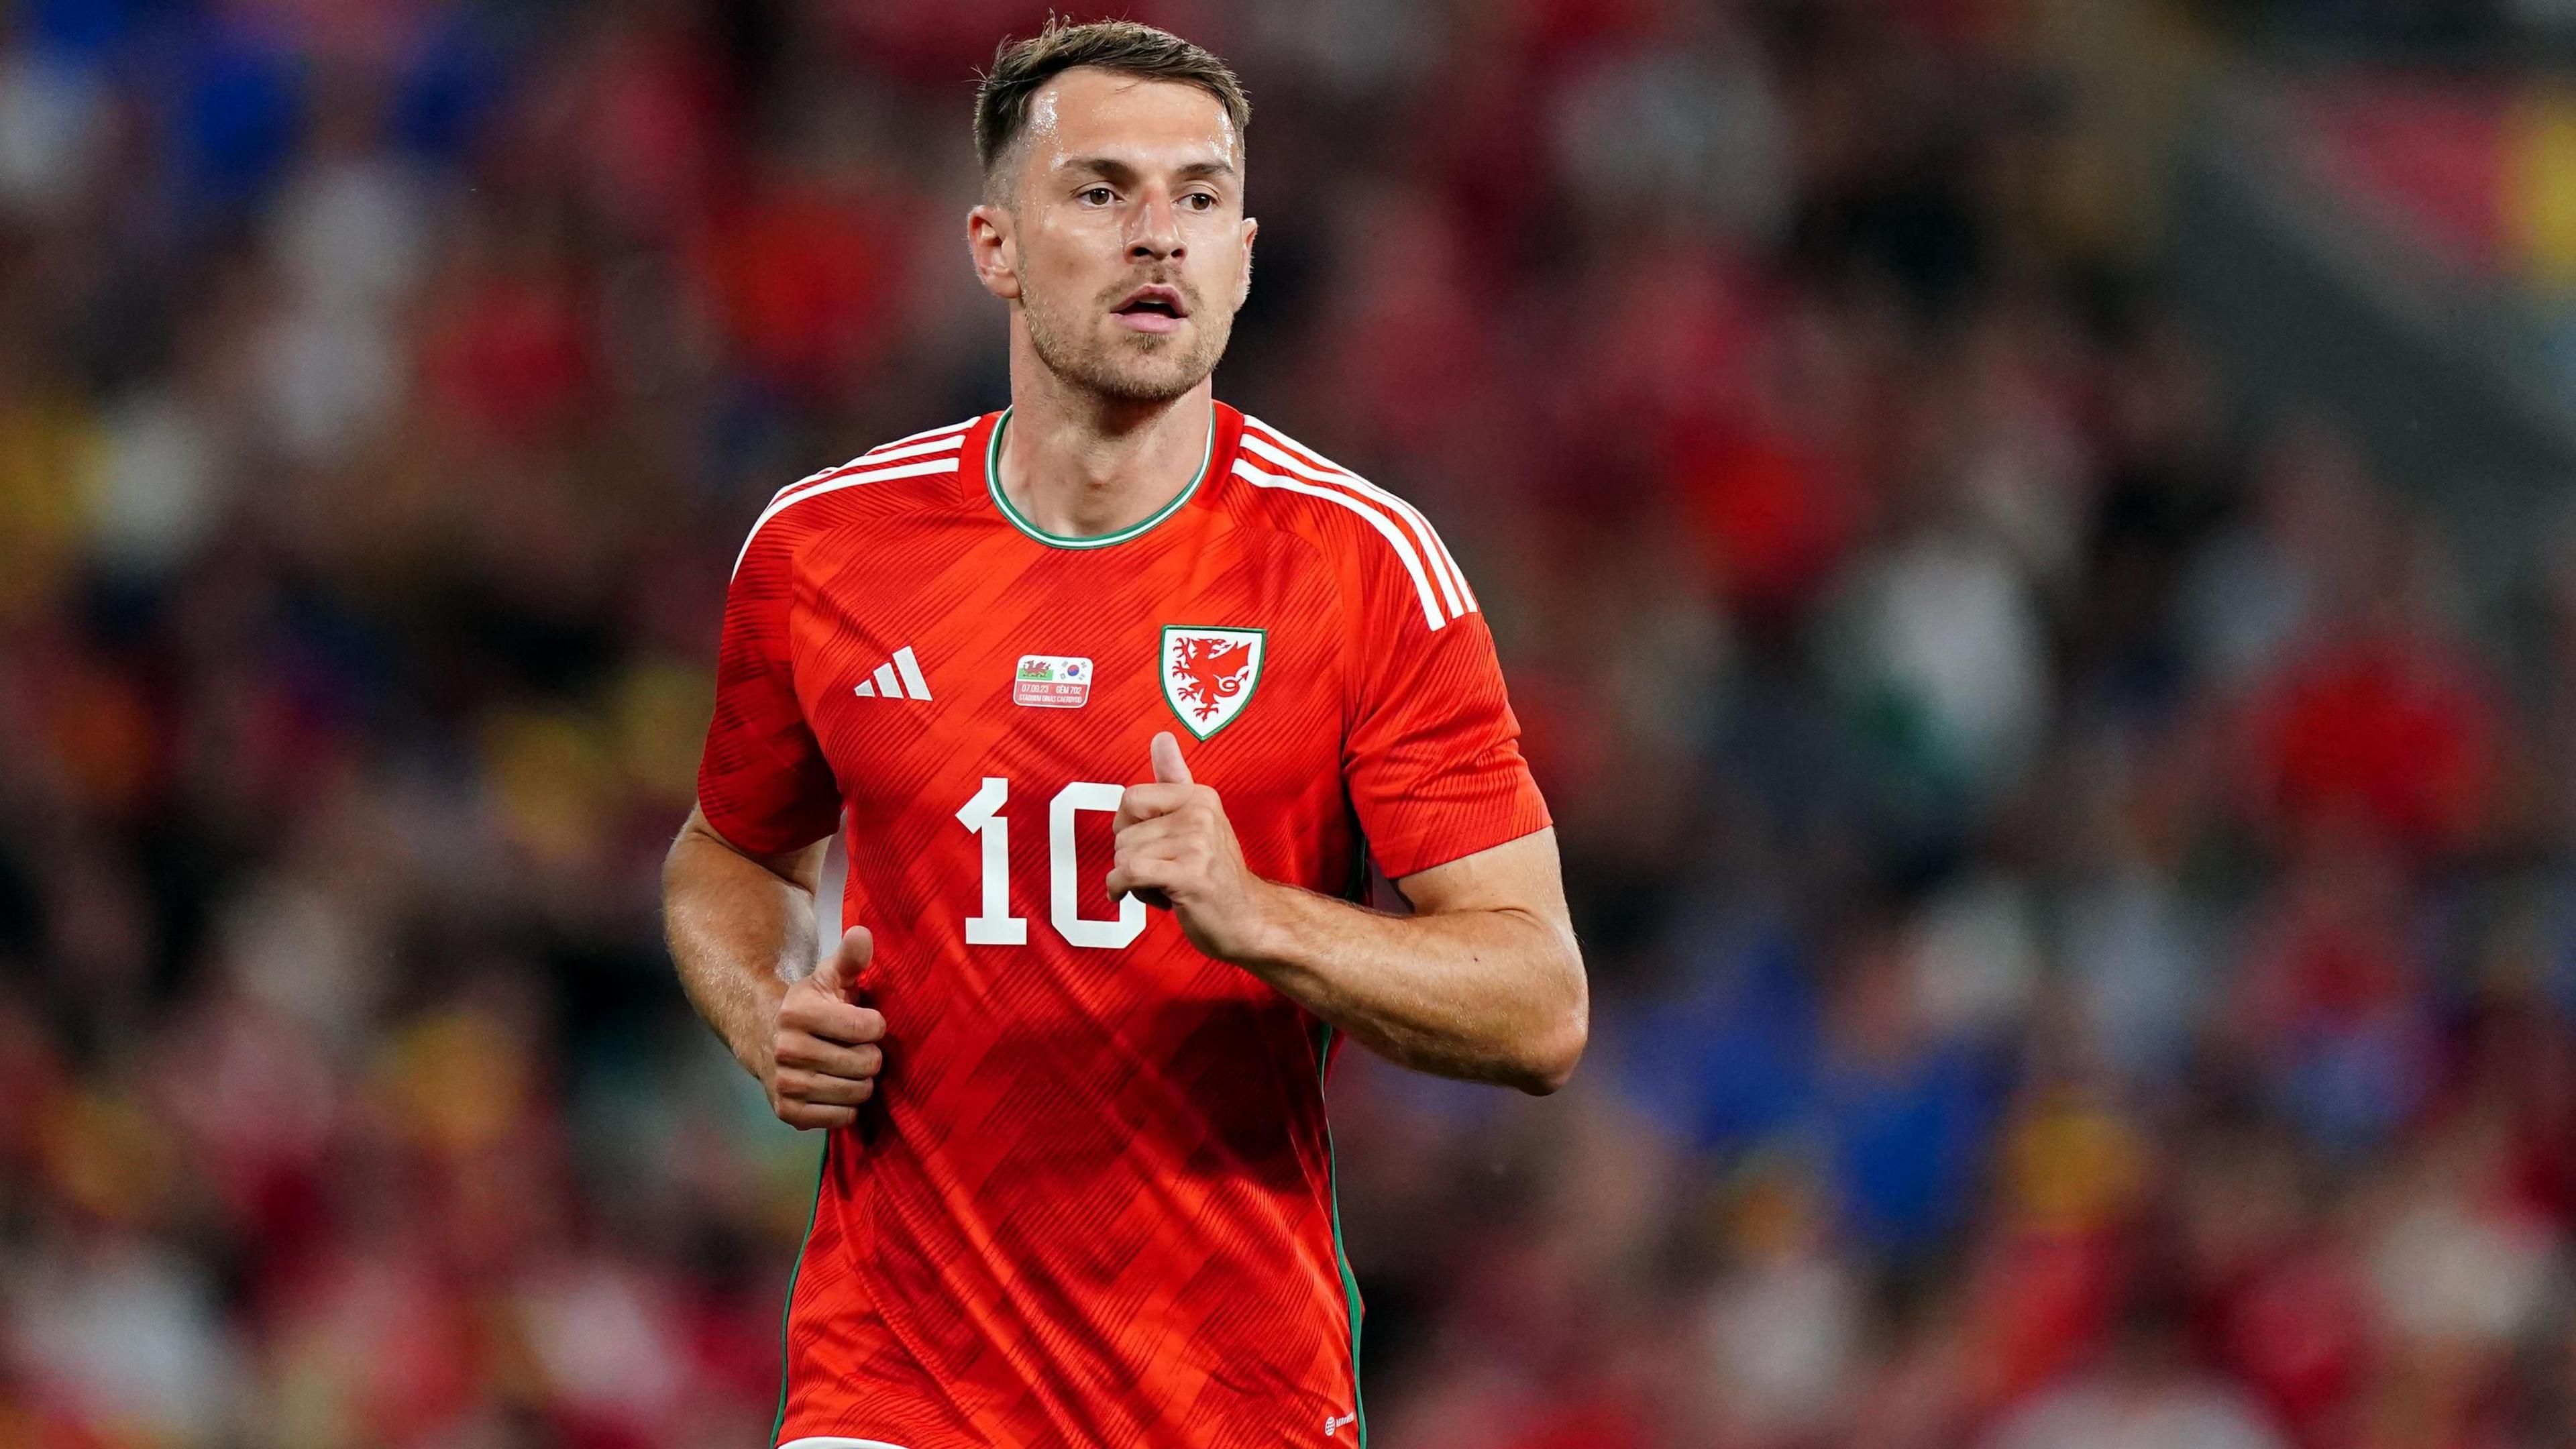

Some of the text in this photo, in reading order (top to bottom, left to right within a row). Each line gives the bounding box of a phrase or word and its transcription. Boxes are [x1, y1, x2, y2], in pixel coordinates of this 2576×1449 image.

[1022, 684, 1049, 693] 07.09.23
[1070, 686, 1082, 694] 702
[955, 777, 1146, 949] 10
